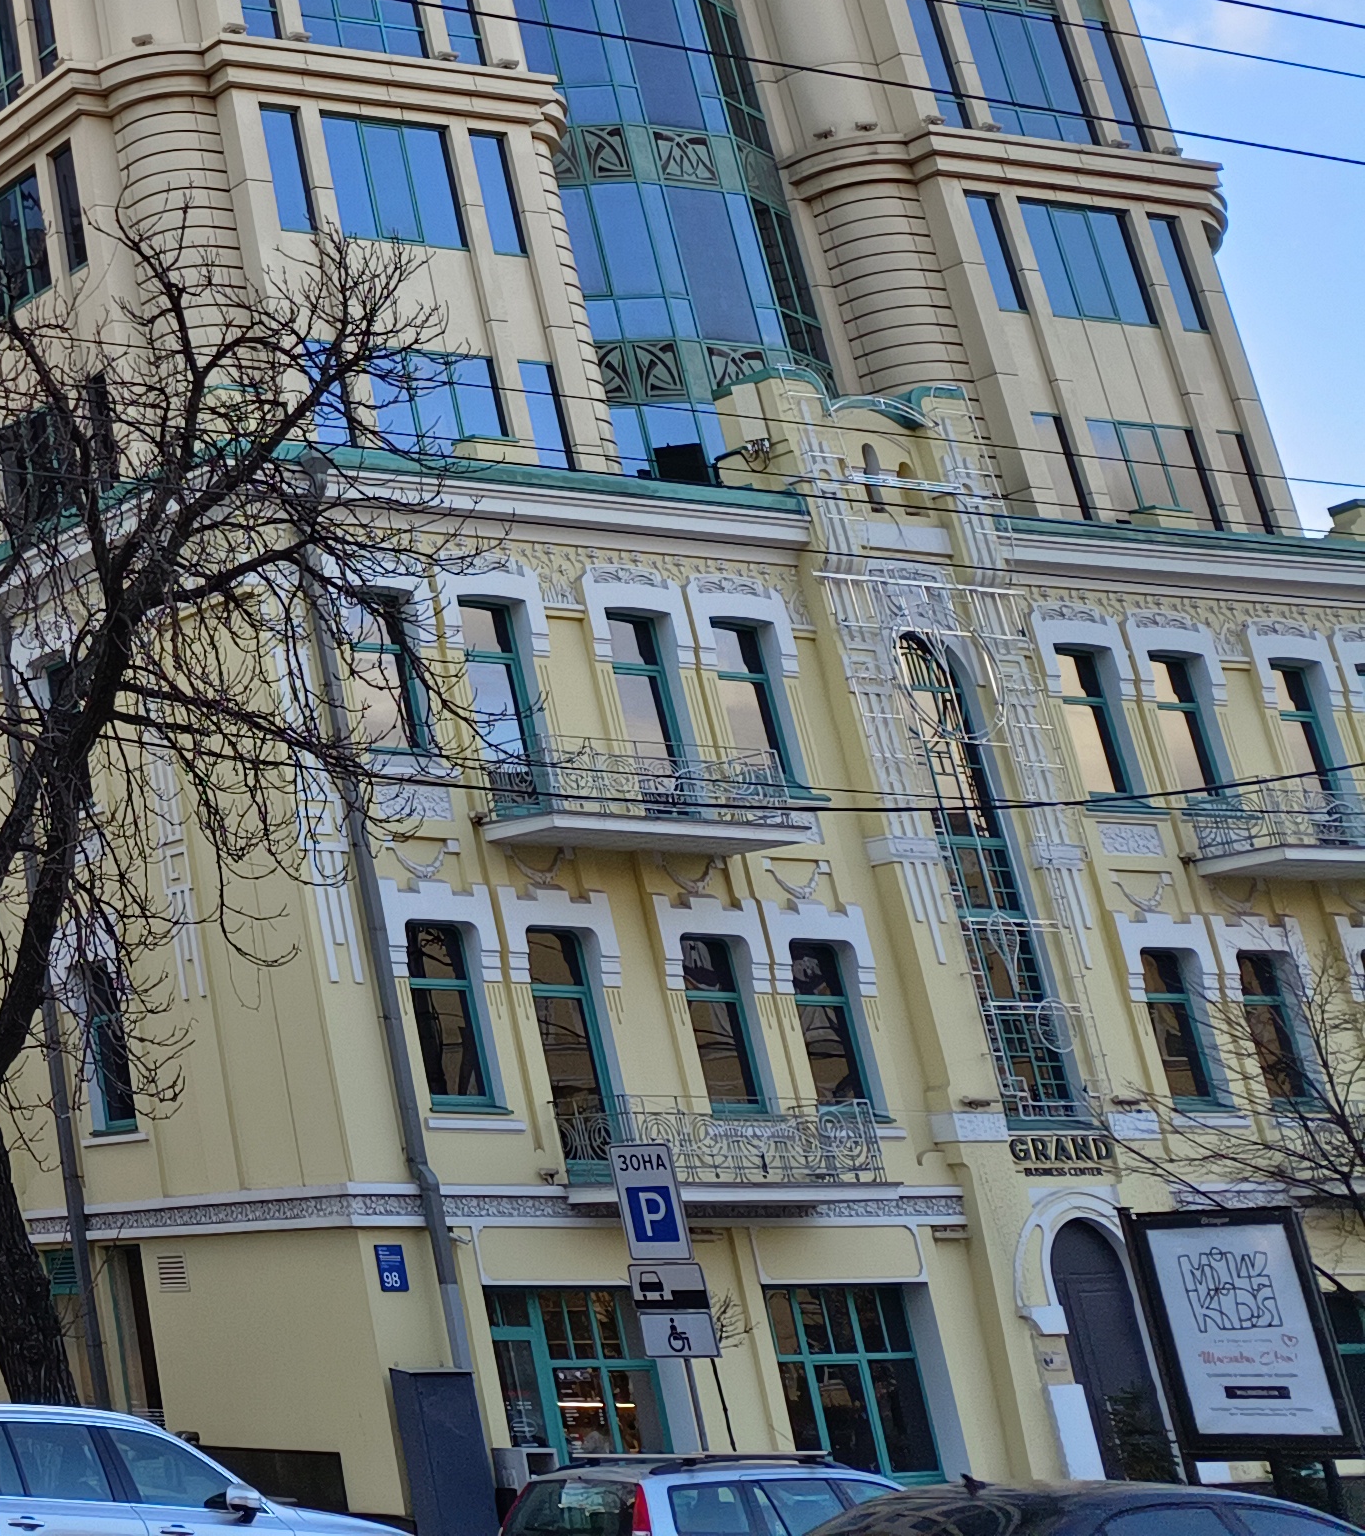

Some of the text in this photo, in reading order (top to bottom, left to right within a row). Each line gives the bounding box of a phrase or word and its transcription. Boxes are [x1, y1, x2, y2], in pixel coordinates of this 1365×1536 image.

[1009, 1137, 1113, 1161] GRAND
[617, 1153, 668, 1172] ЗОНА
[638, 1191, 667, 1237] P
[383, 1271, 401, 1287] 98
